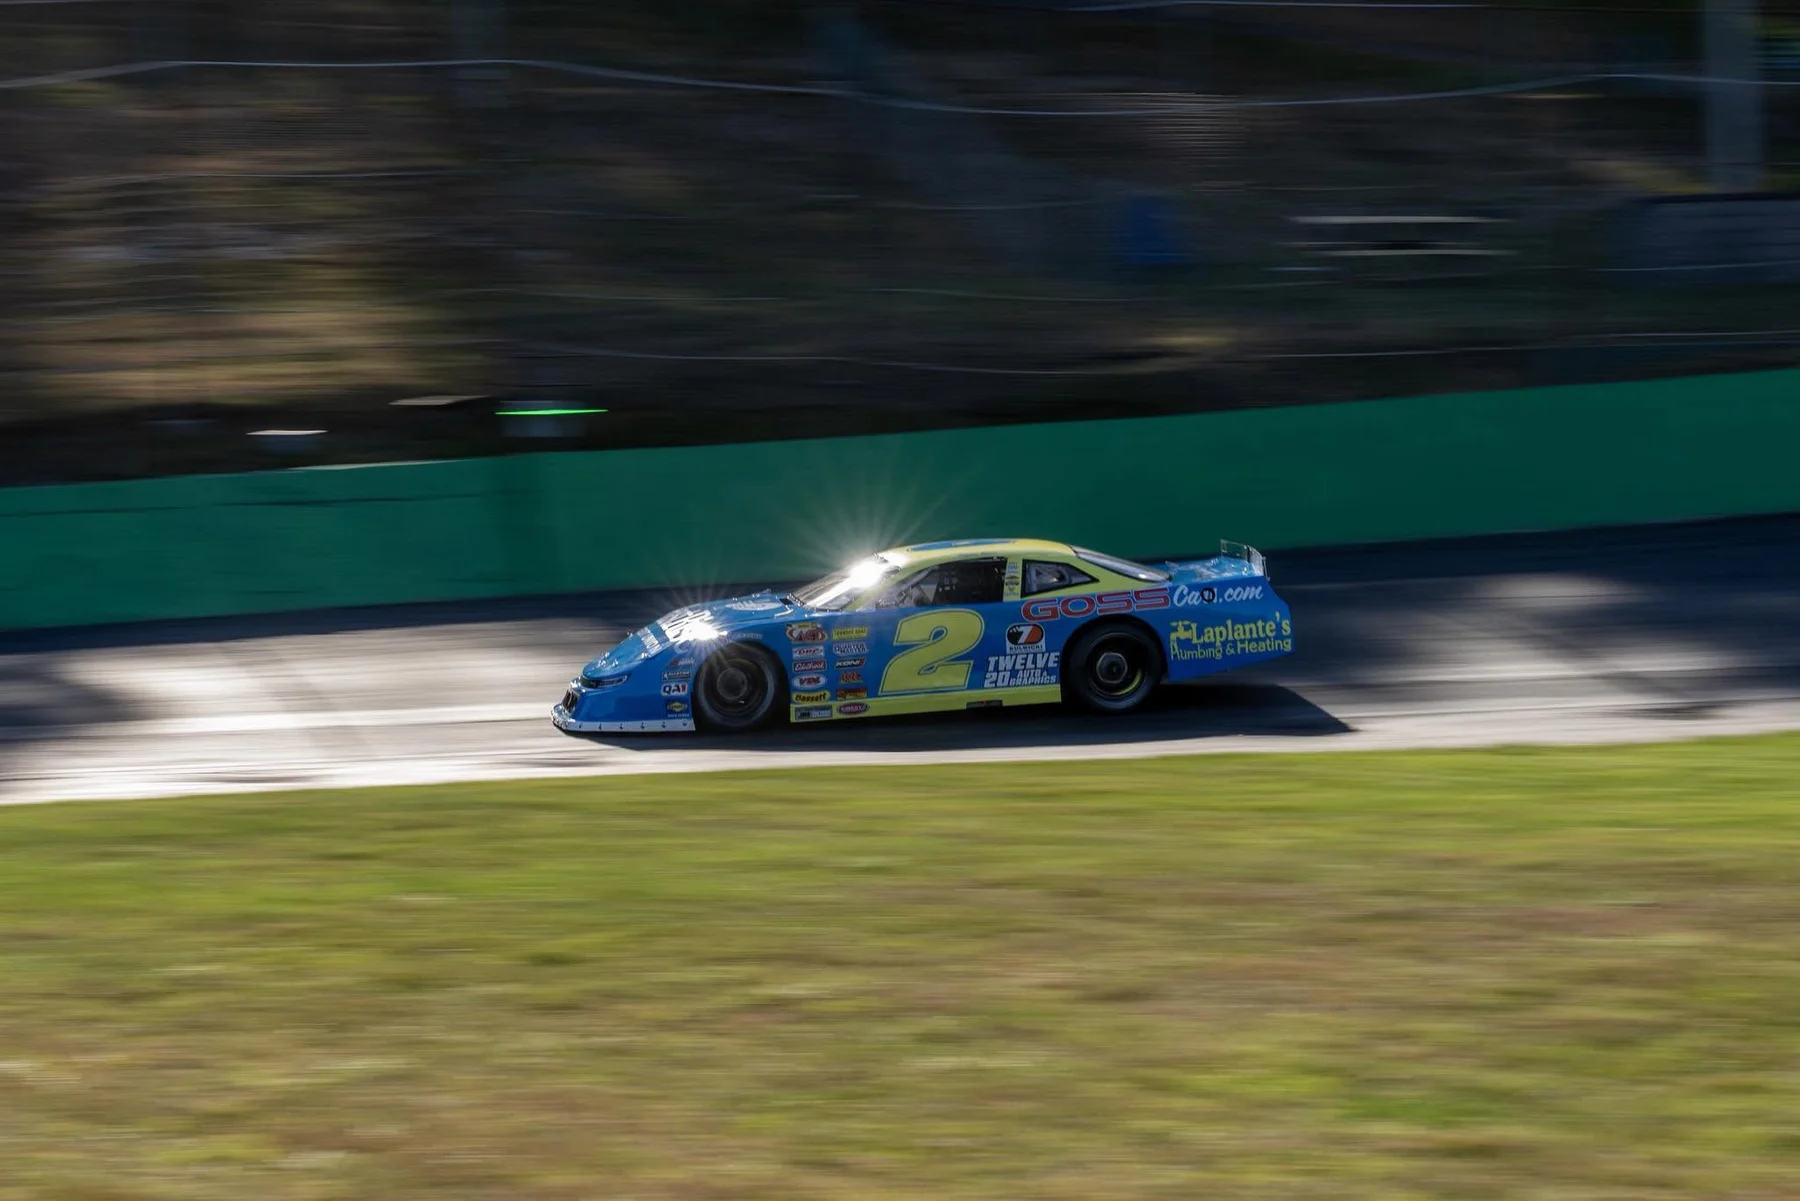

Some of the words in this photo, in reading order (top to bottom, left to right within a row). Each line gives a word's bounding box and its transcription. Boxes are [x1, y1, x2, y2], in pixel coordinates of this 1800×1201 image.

[1021, 587, 1171, 622] GOSS
[1191, 611, 1291, 646] Laplante's
[878, 608, 985, 696] 2
[1226, 643, 1236, 655] &
[1237, 638, 1292, 654] Heating
[988, 652, 1060, 672] TWELVE
[984, 671, 1011, 688] 20
[1017, 669, 1041, 678] AUTO
[662, 683, 687, 695] QA1
